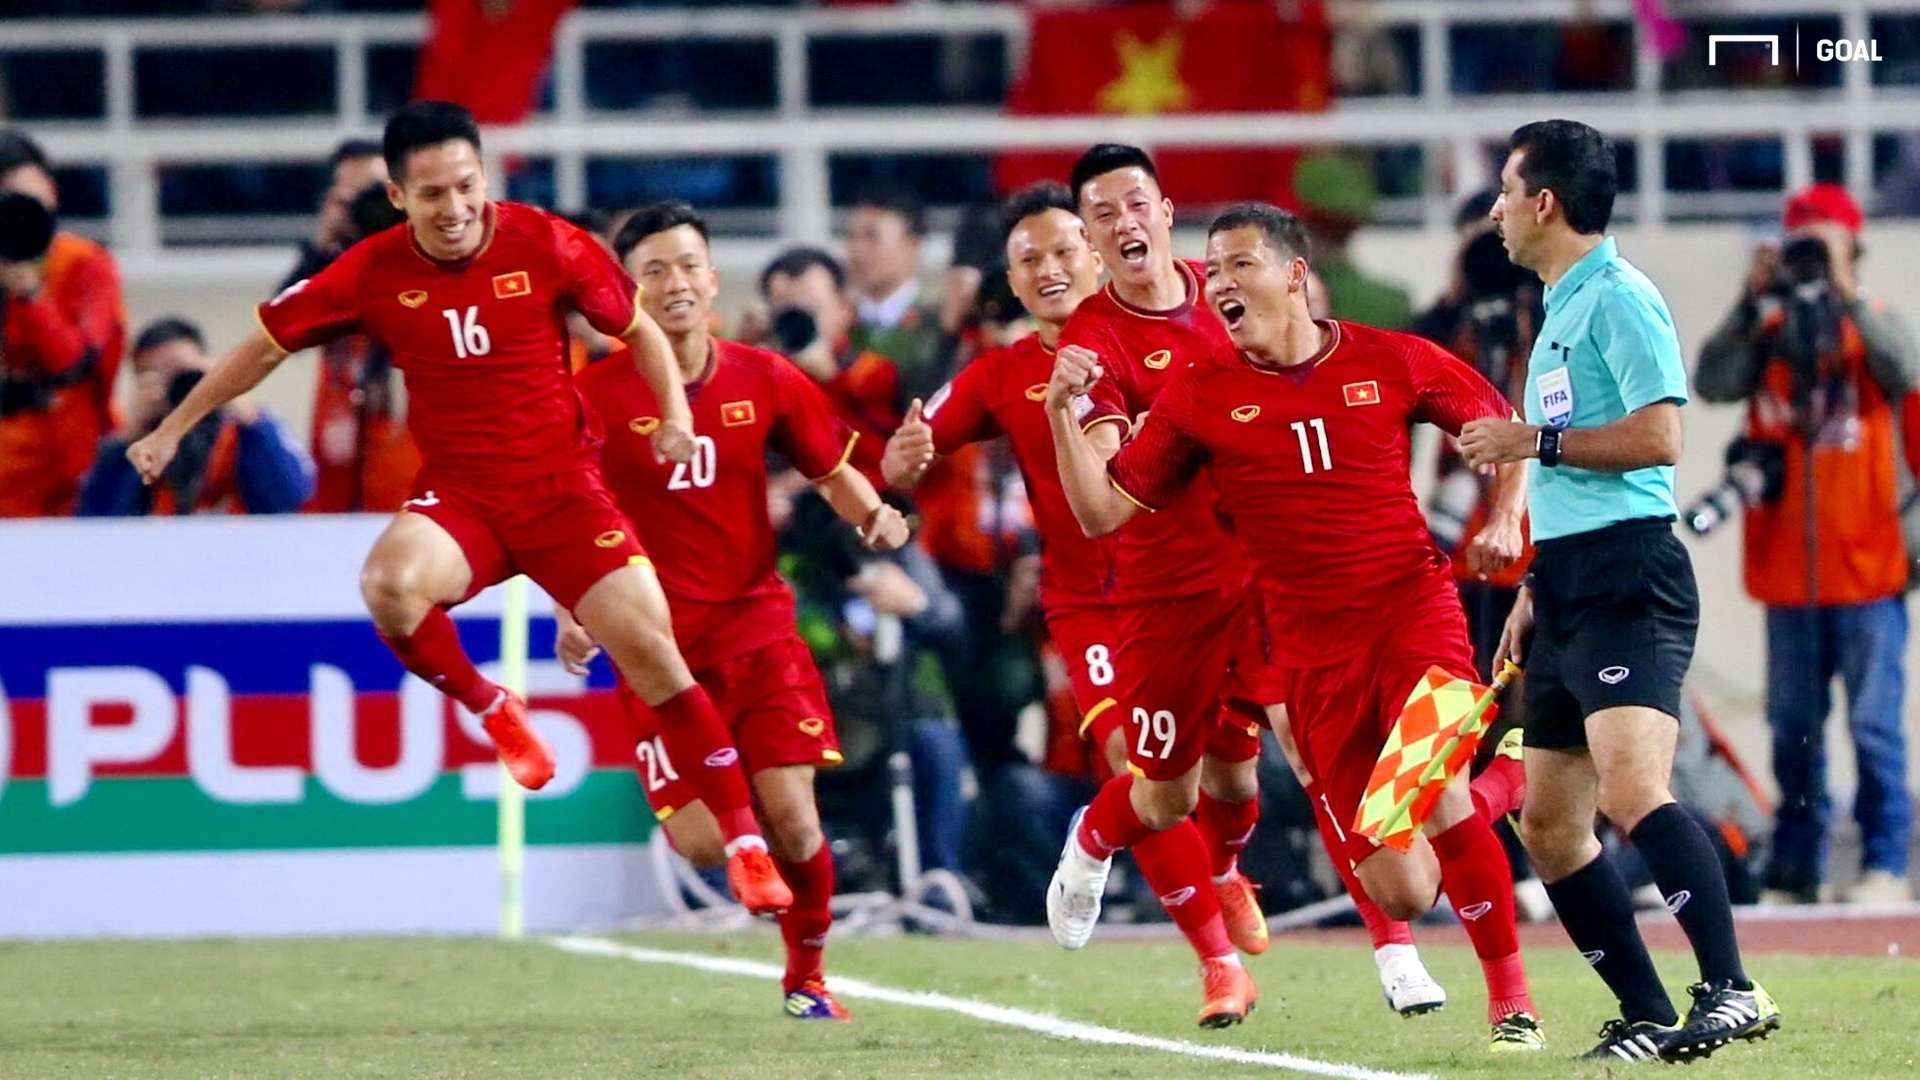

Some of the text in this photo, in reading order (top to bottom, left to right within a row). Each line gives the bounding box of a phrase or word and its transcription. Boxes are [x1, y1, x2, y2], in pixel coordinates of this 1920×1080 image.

[442, 305, 491, 359] 16
[1543, 390, 1568, 408] FIFA
[1290, 417, 1333, 474] 11
[1087, 645, 1114, 687] 8
[46, 662, 593, 806] PLUS
[1132, 706, 1176, 760] 29
